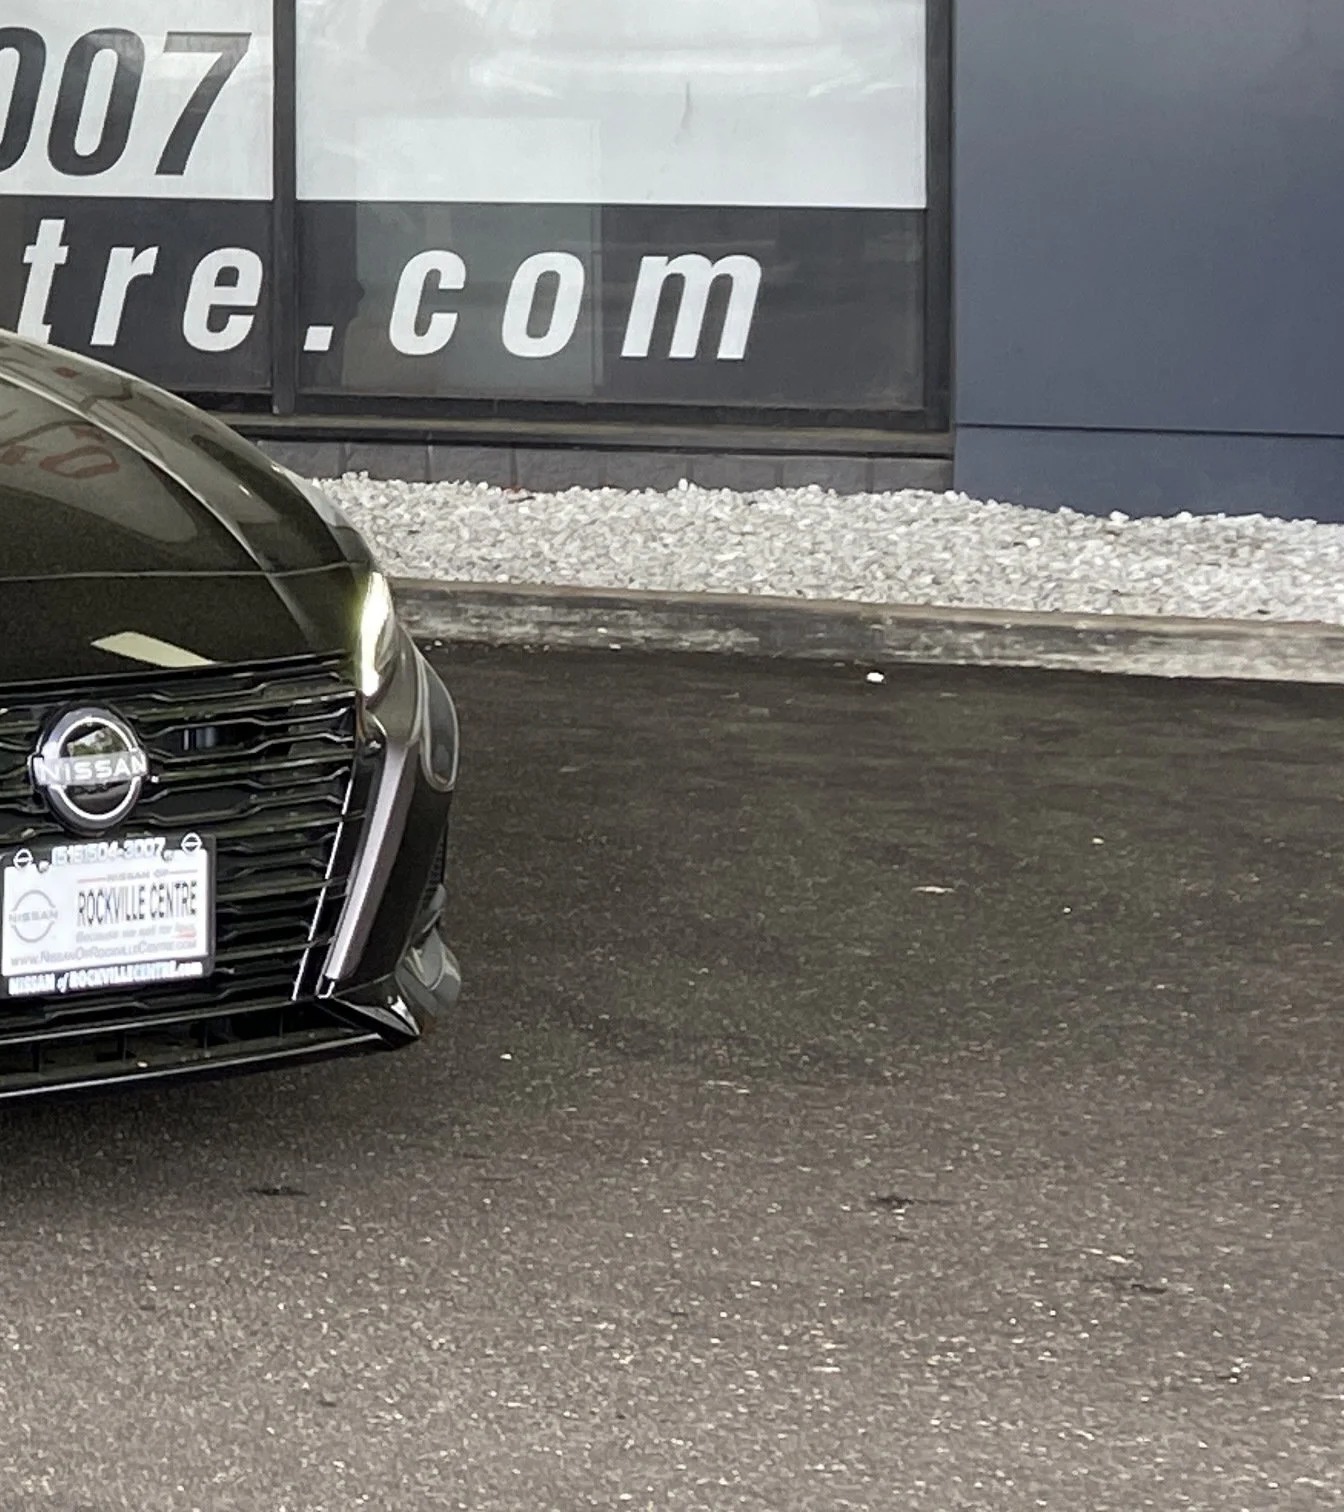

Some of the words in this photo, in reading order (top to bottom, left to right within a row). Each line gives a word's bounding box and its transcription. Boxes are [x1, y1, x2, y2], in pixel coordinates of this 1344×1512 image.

[36, 752, 147, 784] NISSAN
[8, 908, 59, 924] NISSAN
[77, 885, 147, 927] ROCKVILLE
[149, 879, 198, 921] CENTRE
